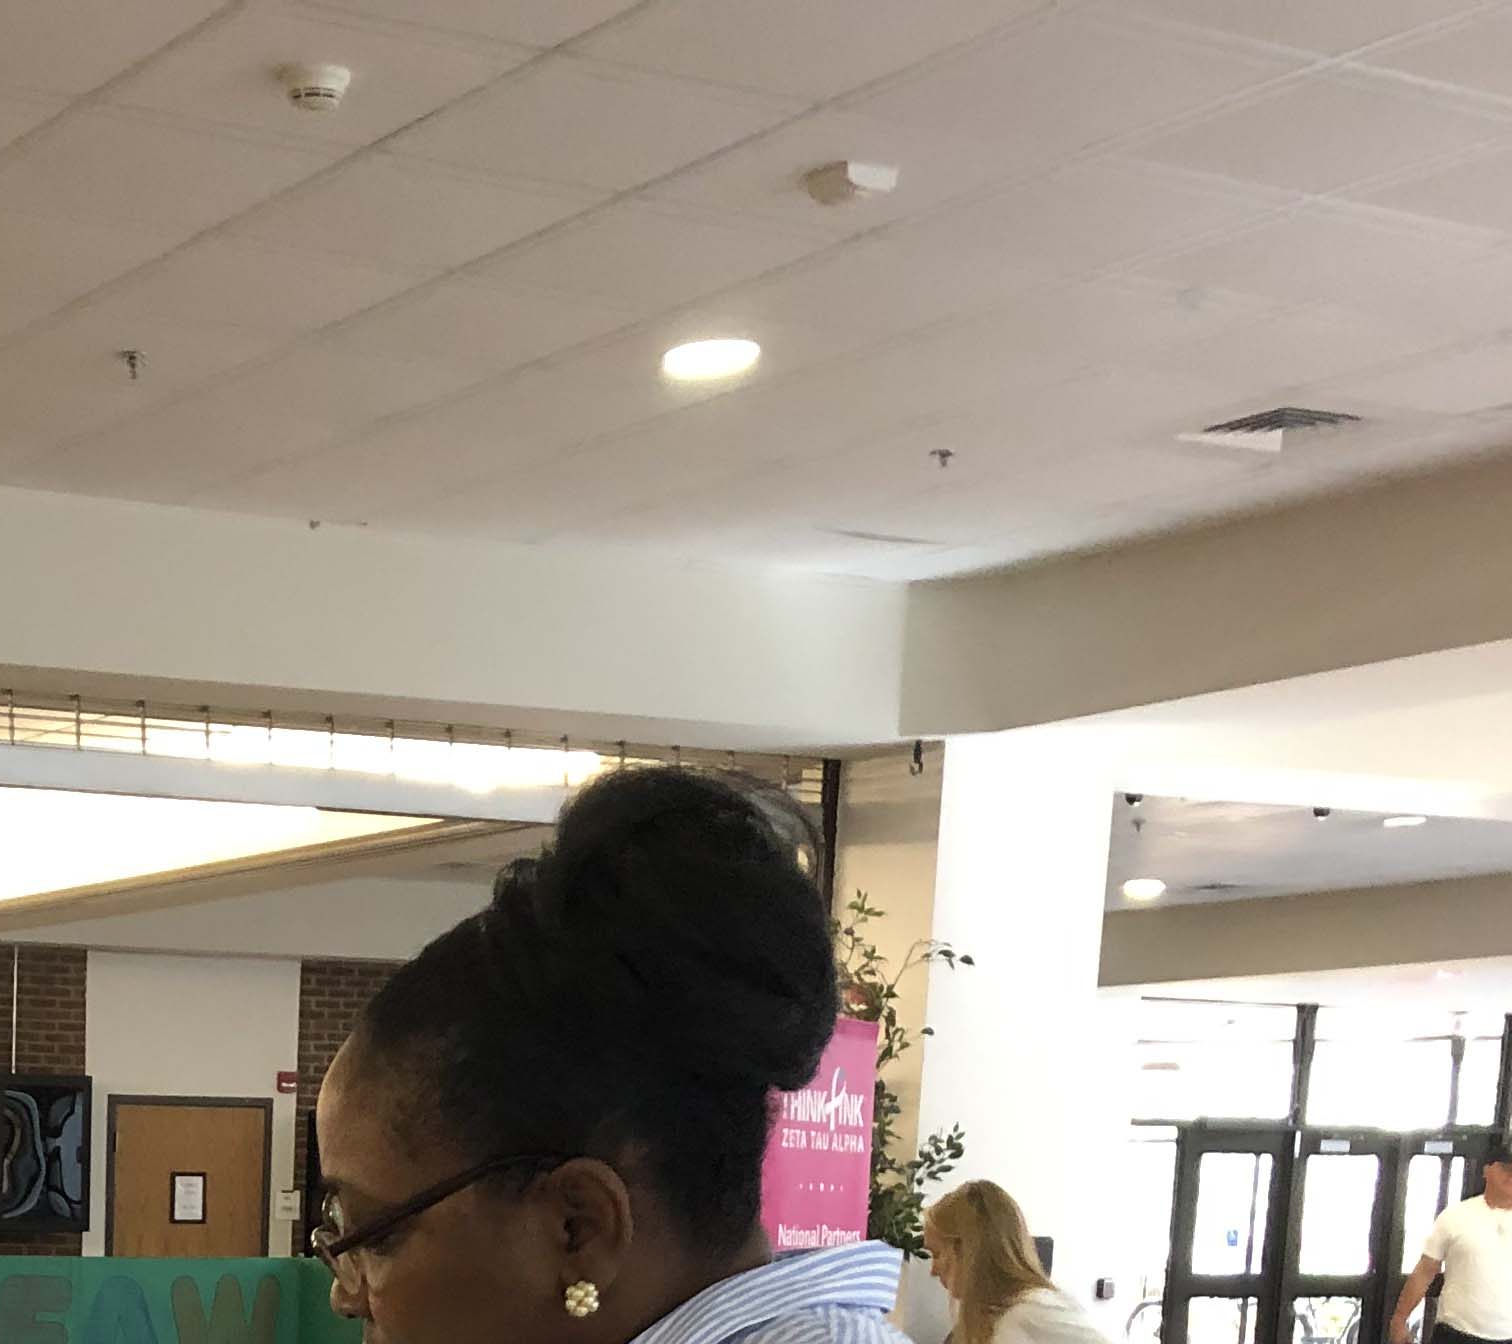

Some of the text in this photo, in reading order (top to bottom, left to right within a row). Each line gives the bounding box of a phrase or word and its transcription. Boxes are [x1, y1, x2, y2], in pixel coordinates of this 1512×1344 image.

[782, 1127, 864, 1153] ZETA TAU ALPHA
[778, 1223, 821, 1249] National
